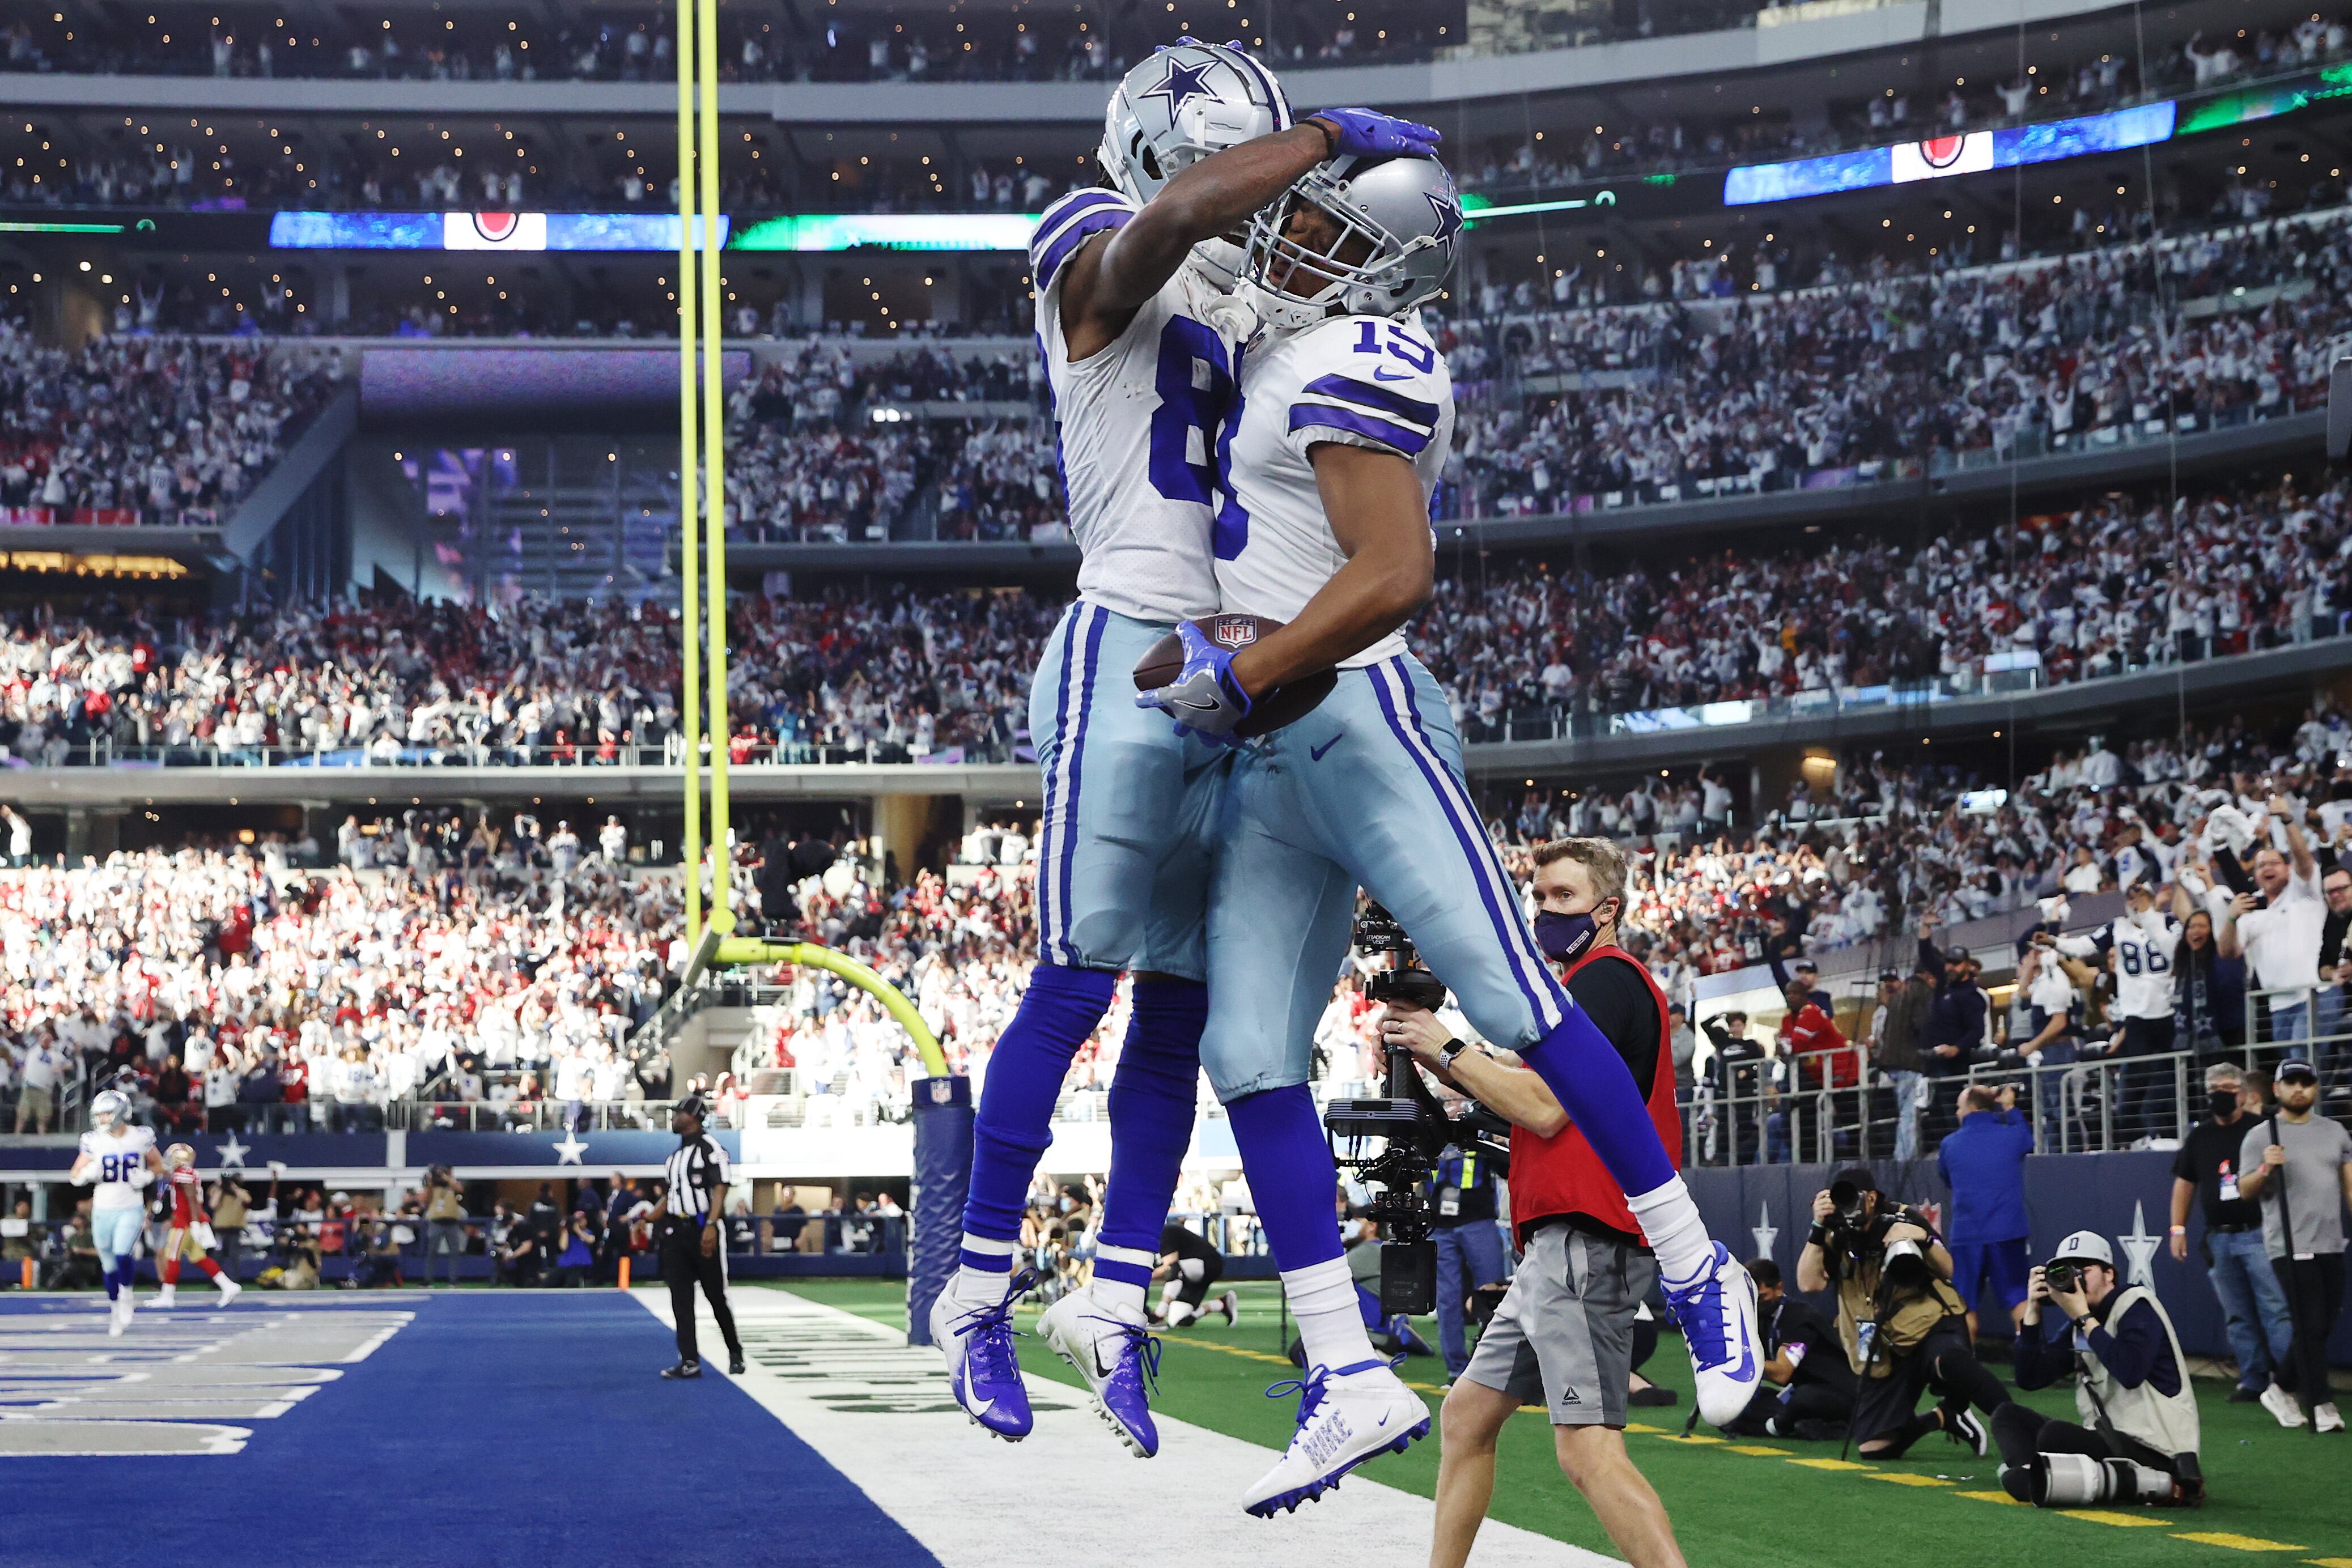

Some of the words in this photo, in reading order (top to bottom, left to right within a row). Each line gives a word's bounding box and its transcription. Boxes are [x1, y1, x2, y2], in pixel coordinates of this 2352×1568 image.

[1220, 626, 1251, 641] NFL
[2068, 1237, 2079, 1251] D
[1302, 1408, 1353, 1471] NIKE
